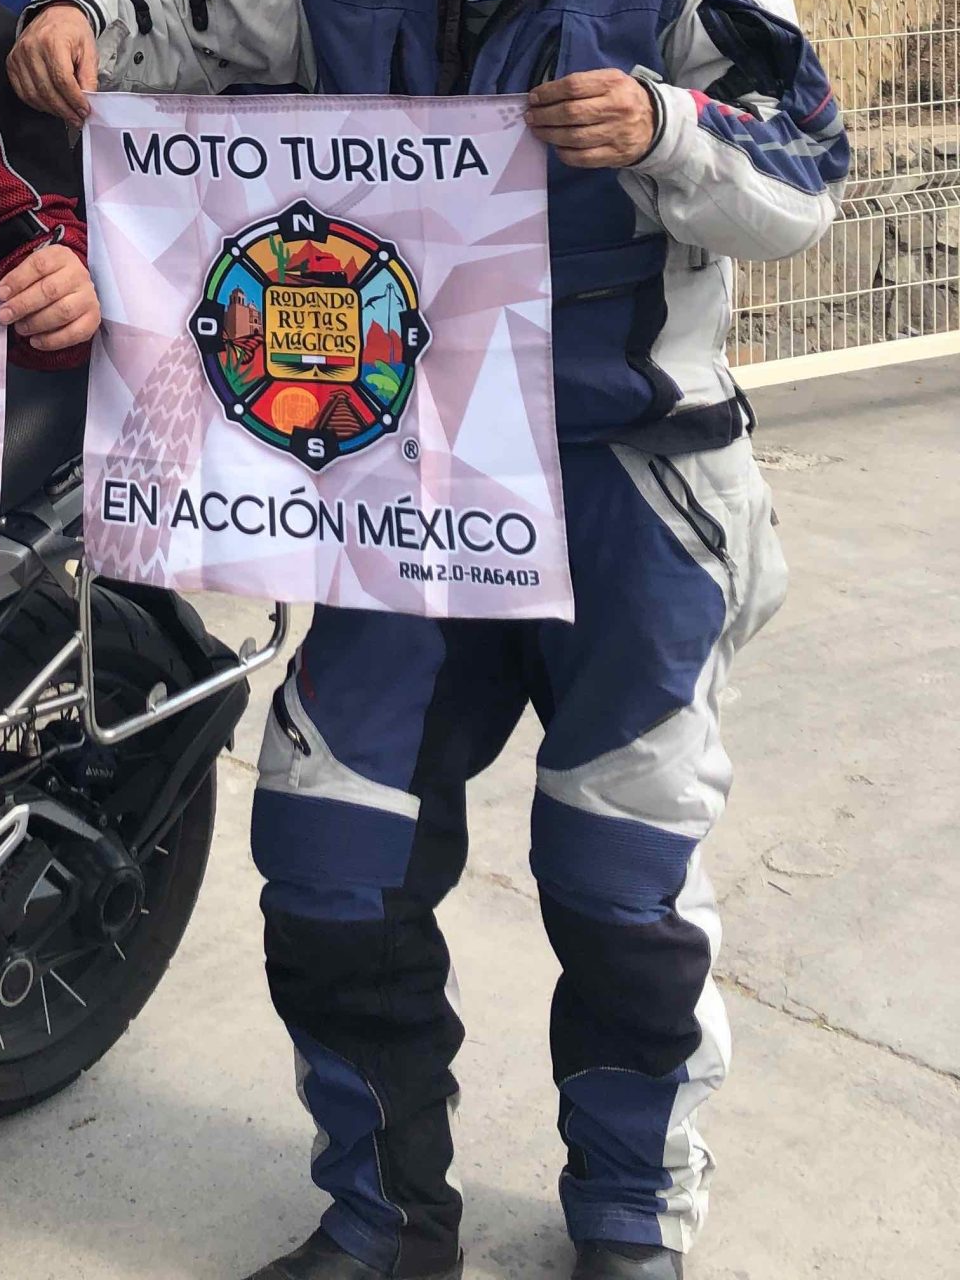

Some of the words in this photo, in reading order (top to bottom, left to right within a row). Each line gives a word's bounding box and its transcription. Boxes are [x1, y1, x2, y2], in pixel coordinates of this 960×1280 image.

[122, 131, 269, 180] MOTO
[280, 135, 489, 183] TURISTA
[292, 213, 314, 232] N
[407, 327, 419, 347] E
[307, 437, 326, 457] S
[103, 480, 158, 527] EN
[170, 486, 345, 544] ACCIÓN
[357, 496, 537, 556] MÉXICO
[399, 561, 434, 582] RRM
